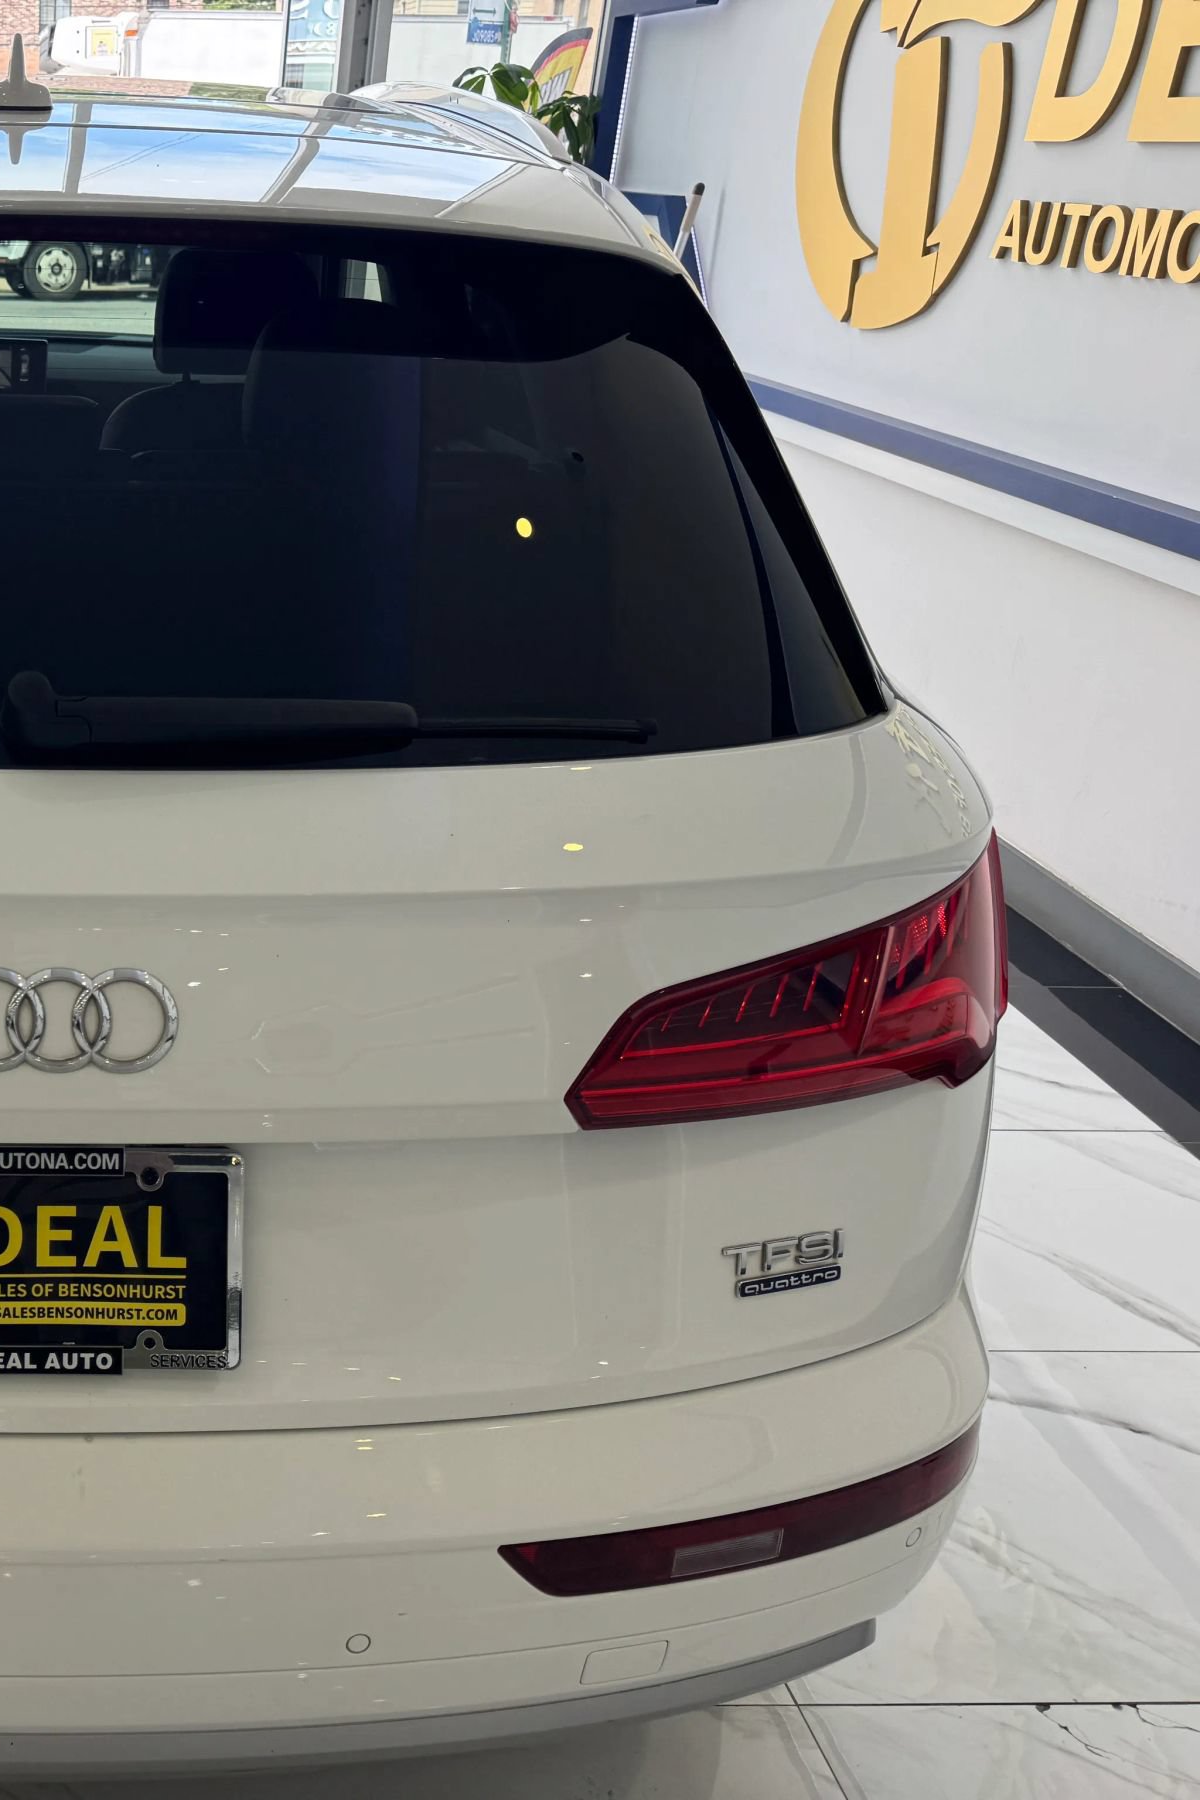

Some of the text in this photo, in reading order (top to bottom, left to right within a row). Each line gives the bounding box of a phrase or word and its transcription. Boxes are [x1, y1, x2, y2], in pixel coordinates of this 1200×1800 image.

[722, 1228, 844, 1276] TFSI
[31, 1283, 55, 1298] OF
[58, 1284, 186, 1300] BENSONHURST
[744, 1270, 838, 1295] quattro
[45, 1353, 114, 1371] AUTO
[150, 1354, 228, 1369] SERVICES
